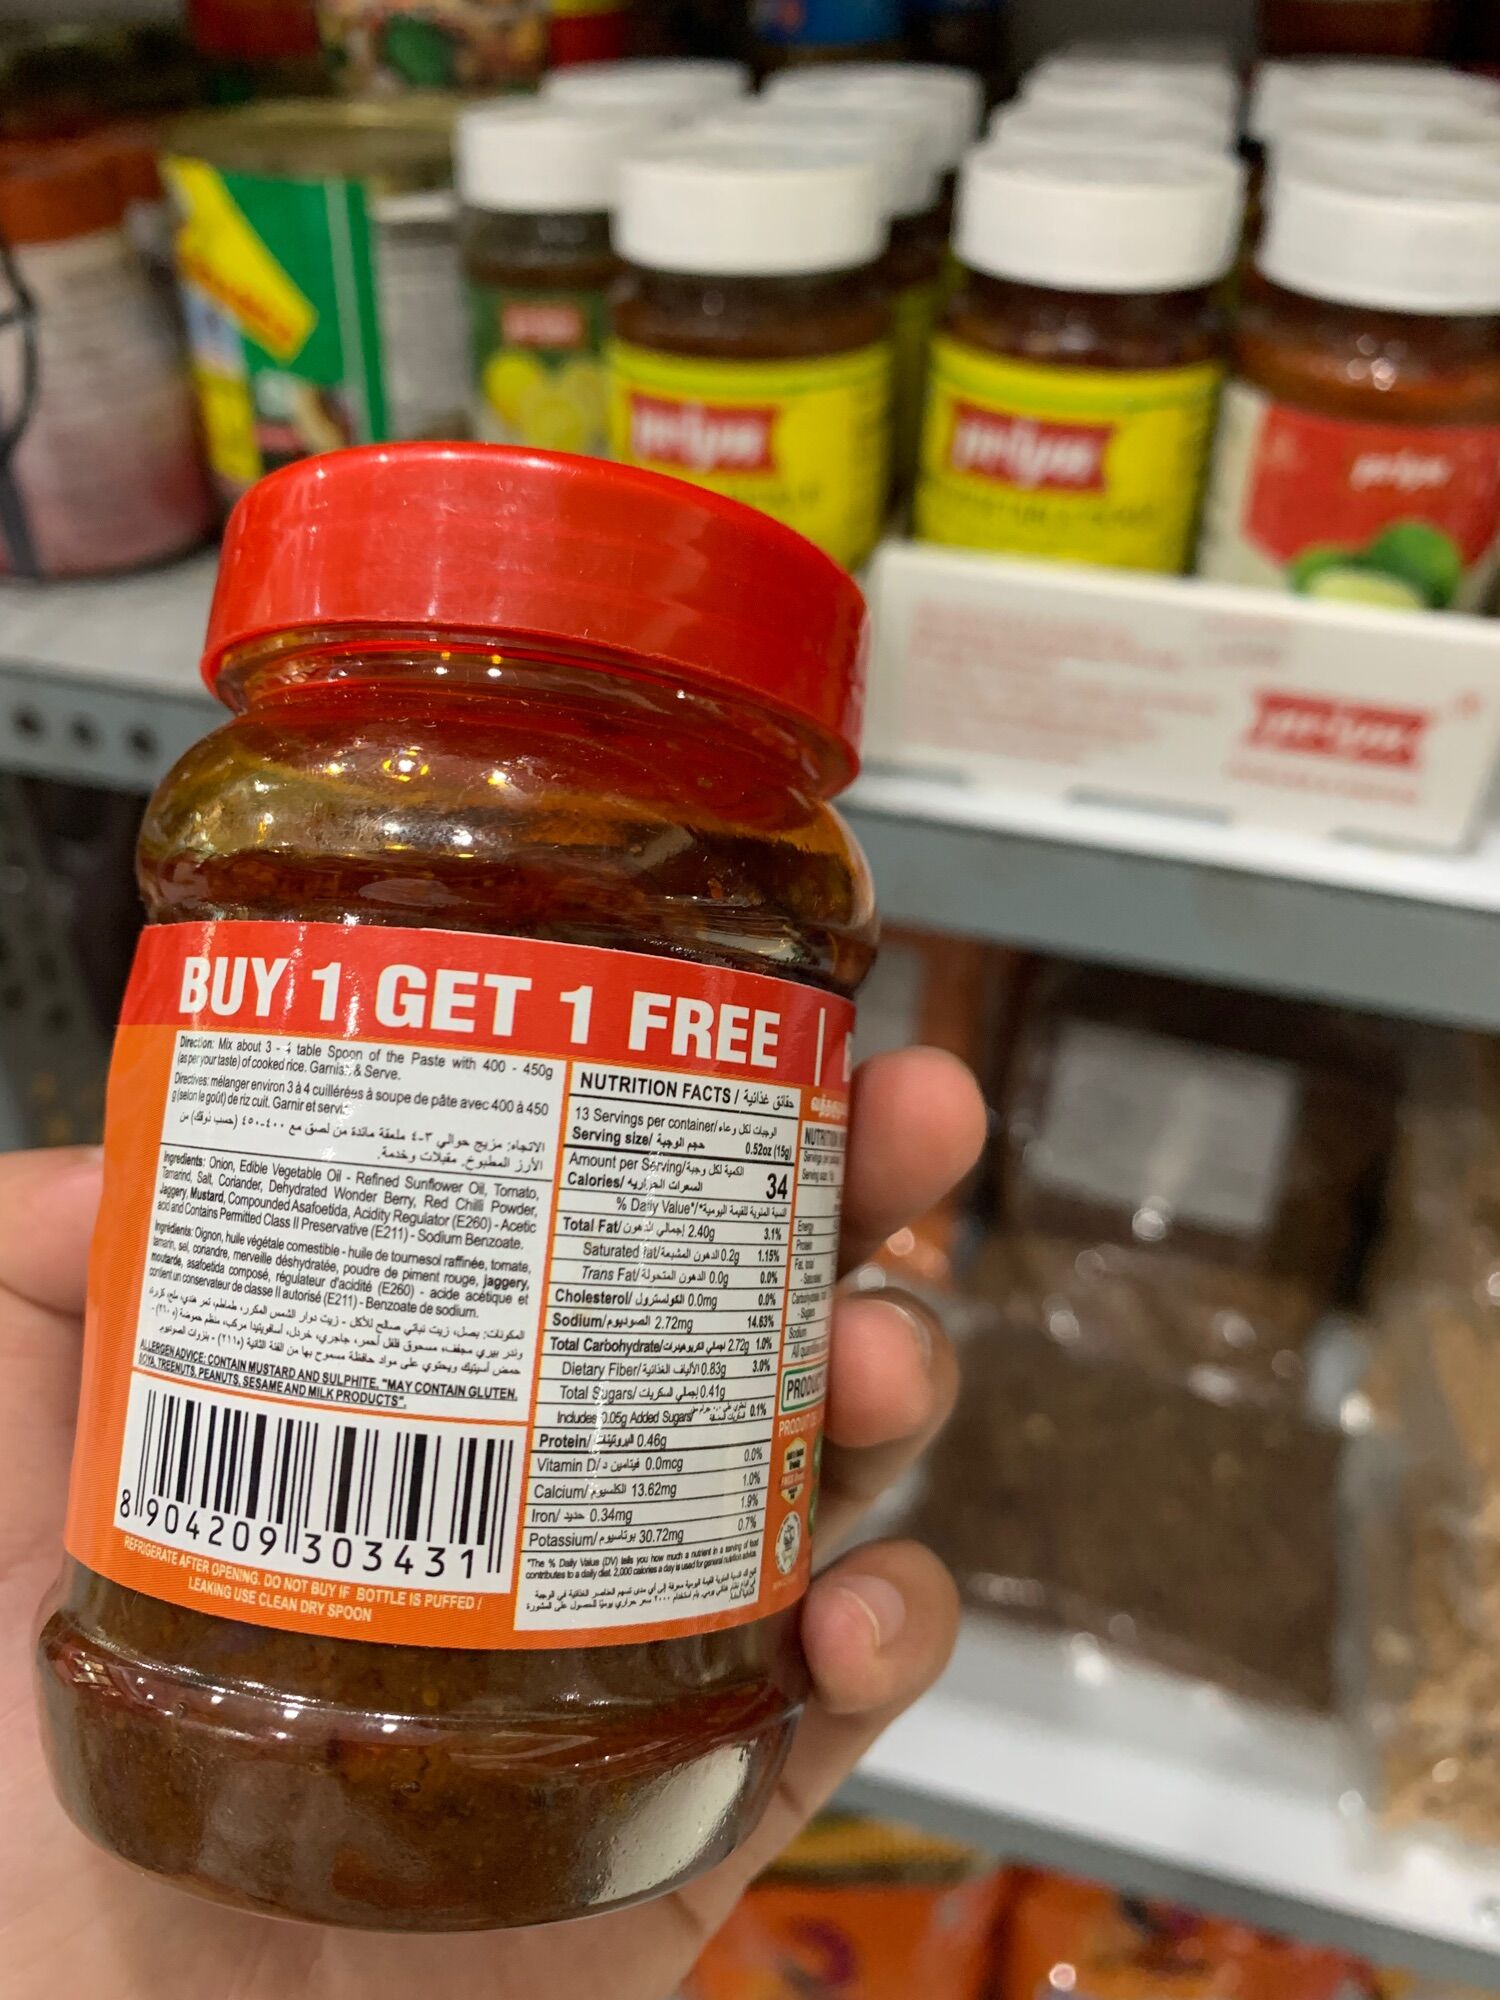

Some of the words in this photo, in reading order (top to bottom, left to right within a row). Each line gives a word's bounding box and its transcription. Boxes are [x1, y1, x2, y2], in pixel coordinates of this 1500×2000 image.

[179, 956, 290, 1017] BUY
[312, 962, 341, 1021] 1
[375, 964, 532, 1036] GET
[560, 985, 593, 1044] 1
[628, 990, 780, 1068] FREE
[178, 1053, 187, 1064] (as
[200, 1054, 216, 1067] your
[218, 1055, 241, 1069] taste)
[242, 1056, 251, 1068] of
[252, 1057, 284, 1071] cooked
[286, 1060, 307, 1072] rice.
[354, 1064, 361, 1076] &
[365, 1065, 402, 1080] Serve.
[180, 1035, 214, 1048] Direction:
[218, 1037, 232, 1050] Mix
[237, 1039, 261, 1053] about
[266, 1041, 271, 1053] 3
[297, 1043, 321, 1056] table
[328, 1045, 362, 1060] Spoon
[369, 1049, 382, 1062] of
[387, 1051, 404, 1064] the
[412, 1052, 445, 1067] Paste
[453, 1057, 475, 1070] with
[483, 1060, 505, 1073] 400
[524, 1063, 553, 1080] 450g
[580, 1072, 678, 1098] NUTRITION
[682, 1083, 730, 1104] FACTS
[576, 1107, 589, 1121] 13
[594, 1110, 643, 1128] Servings
[648, 1116, 664, 1128] per
[572, 1127, 620, 1145] Serving
[745, 1144, 771, 1156] 0.52oz
[773, 1144, 792, 1160] (15g)
[570, 1152, 616, 1169] Amount
[619, 1157, 638, 1173] per
[164, 1152, 206, 1167] Ingredients:
[209, 1156, 235, 1172] Onion,
[240, 1160, 268, 1174] Edible
[273, 1163, 321, 1180] Vegetable
[327, 1168, 341, 1181] Oil
[356, 1171, 399, 1188] Refined
[405, 1175, 463, 1193] Sunflower
[469, 1181, 487, 1197] Oil,
[494, 1184, 539, 1200] Tomato,
[766, 1173, 787, 1200] 34
[162, 1166, 193, 1182] Tamarind,
[197, 1171, 213, 1185] Salt,
[219, 1174, 262, 1192] Coriander,
[269, 1179, 327, 1198] Dehydrated
[334, 1187, 377, 1203] Wonder
[384, 1192, 416, 1209] Berry,
[424, 1194, 448, 1209] Red
[456, 1198, 483, 1212] Chilli
[491, 1201, 537, 1217] Powder,
[563, 1217, 594, 1231] Total
[688, 1226, 715, 1242] 2.40g
[764, 1227, 781, 1241] 3.1%
[583, 1242, 639, 1257] Saturated
[721, 1250, 739, 1265] 0.2g
[758, 1249, 780, 1262] 1.15%
[582, 1265, 613, 1280] Trans
[709, 1272, 728, 1288] 0.0g
[760, 1272, 777, 1284] 0.0%
[688, 1295, 717, 1310] 0.0mg
[758, 1294, 776, 1306] 0.0%
[655, 1316, 693, 1333] 2.72mg
[747, 1315, 774, 1328] 14.63%
[551, 1337, 579, 1351] Total
[728, 1338, 749, 1354] 2.72g
[756, 1337, 772, 1350] 1.0%
[140, 1338, 177, 1357] ALLERGEN
[175, 1346, 206, 1361] ADVICE:
[208, 1354, 246, 1369] CONTAIN
[249, 1360, 294, 1378] MUSTARD
[299, 1369, 319, 1381] AND
[383, 1379, 411, 1391] "MAY
[414, 1381, 465, 1397] CONTAIN
[562, 1362, 604, 1380] Dietary
[701, 1362, 726, 1378] 0.83g
[752, 1360, 770, 1373] 3.0%
[243, 1376, 282, 1392] SESAME
[285, 1383, 306, 1395] AND
[308, 1386, 333, 1399] MILK
[560, 1385, 588, 1399] Total
[700, 1385, 725, 1400] 0.41g
[637, 1434, 667, 1450] 0.46g
[632, 1482, 676, 1498] 13.62mg
[743, 1471, 760, 1486] 1.0%
[590, 1508, 632, 1525] 0.34mg
[119, 1489, 131, 1517] 8
[145, 1498, 277, 1556] 904209
[302, 1534, 475, 1579] 303431
[639, 1527, 683, 1543] 30.72mg
[738, 1518, 756, 1531] 0.7%
[124, 1536, 177, 1564] REFRIGERATE
[179, 1552, 210, 1574] AFTER
[212, 1562, 261, 1586] OPENING.
[264, 1573, 280, 1589] DO
[283, 1577, 307, 1593] NOT
[311, 1582, 337, 1598] BUY
[340, 1585, 350, 1598] IF
[356, 1587, 405, 1606] BOTTLE
[409, 1592, 421, 1606] IS
[425, 1594, 474, 1610] PUFFED
[187, 1576, 231, 1599] LEAKING
[234, 1586, 256, 1603] USE
[258, 1591, 298, 1611] CLEAN
[301, 1598, 323, 1616] DRY
[327, 1603, 371, 1622] SPOON
